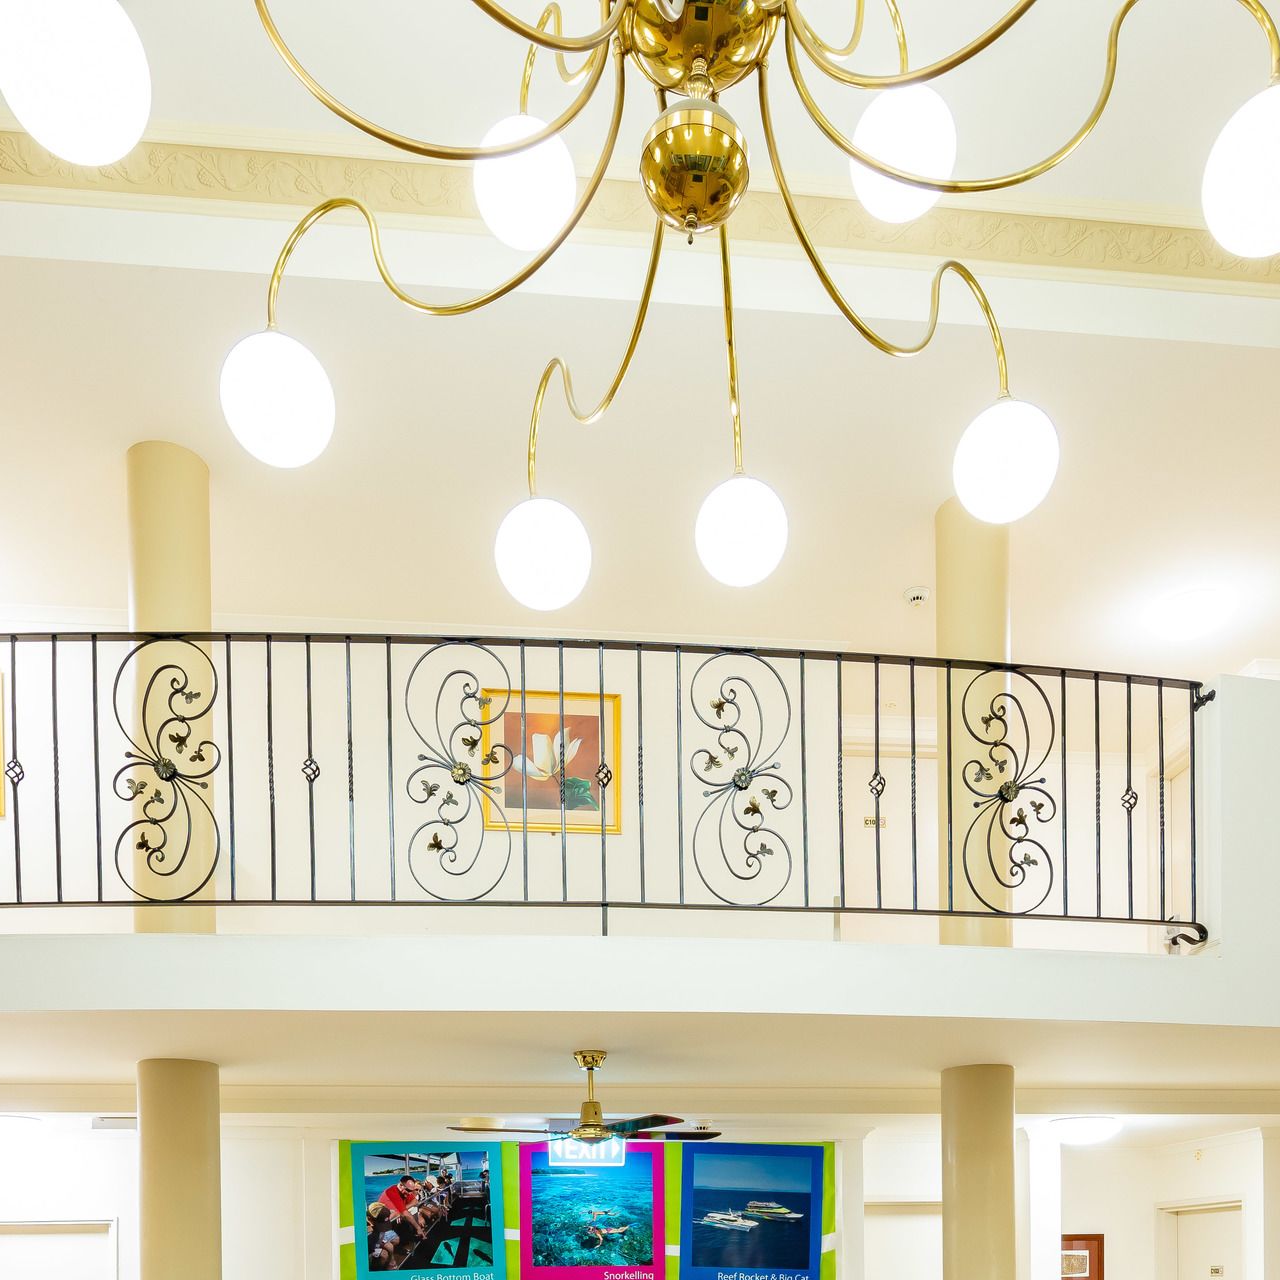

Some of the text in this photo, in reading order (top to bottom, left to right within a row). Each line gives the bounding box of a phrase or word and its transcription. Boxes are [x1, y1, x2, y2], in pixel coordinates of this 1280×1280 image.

[565, 1142, 607, 1160] EXIT
[473, 1272, 494, 1280] Boat
[603, 1271, 654, 1280] Snorkelling
[717, 1272, 738, 1280] Reef
